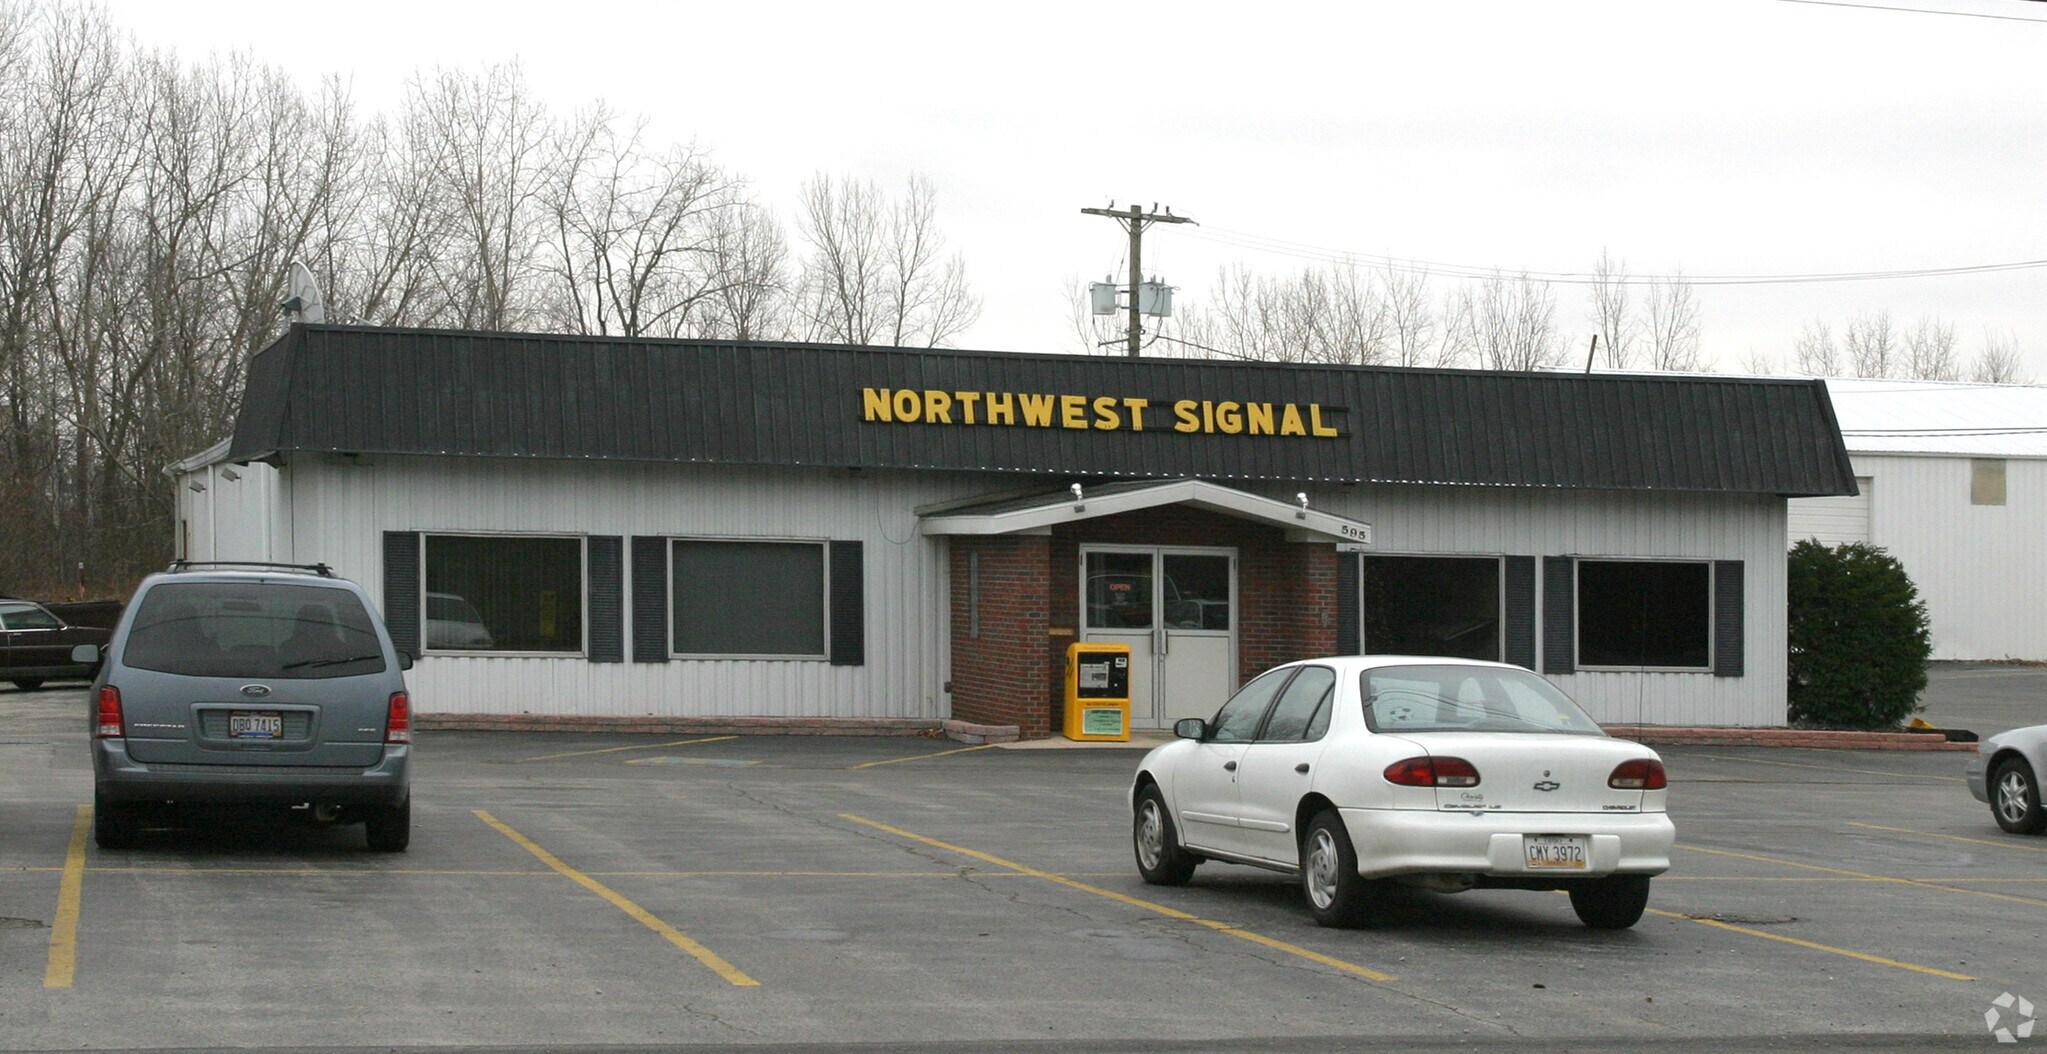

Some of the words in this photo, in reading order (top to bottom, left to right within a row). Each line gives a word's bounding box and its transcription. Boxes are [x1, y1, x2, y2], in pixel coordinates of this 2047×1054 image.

[862, 387, 1148, 432] NORTHWEST
[1173, 399, 1338, 437] SIGNAL
[1341, 525, 1366, 540] 595
[1109, 583, 1131, 592] OPEN
[254, 718, 280, 732] 7415
[1529, 845, 1549, 862] CMY
[1553, 845, 1582, 862] 3972
